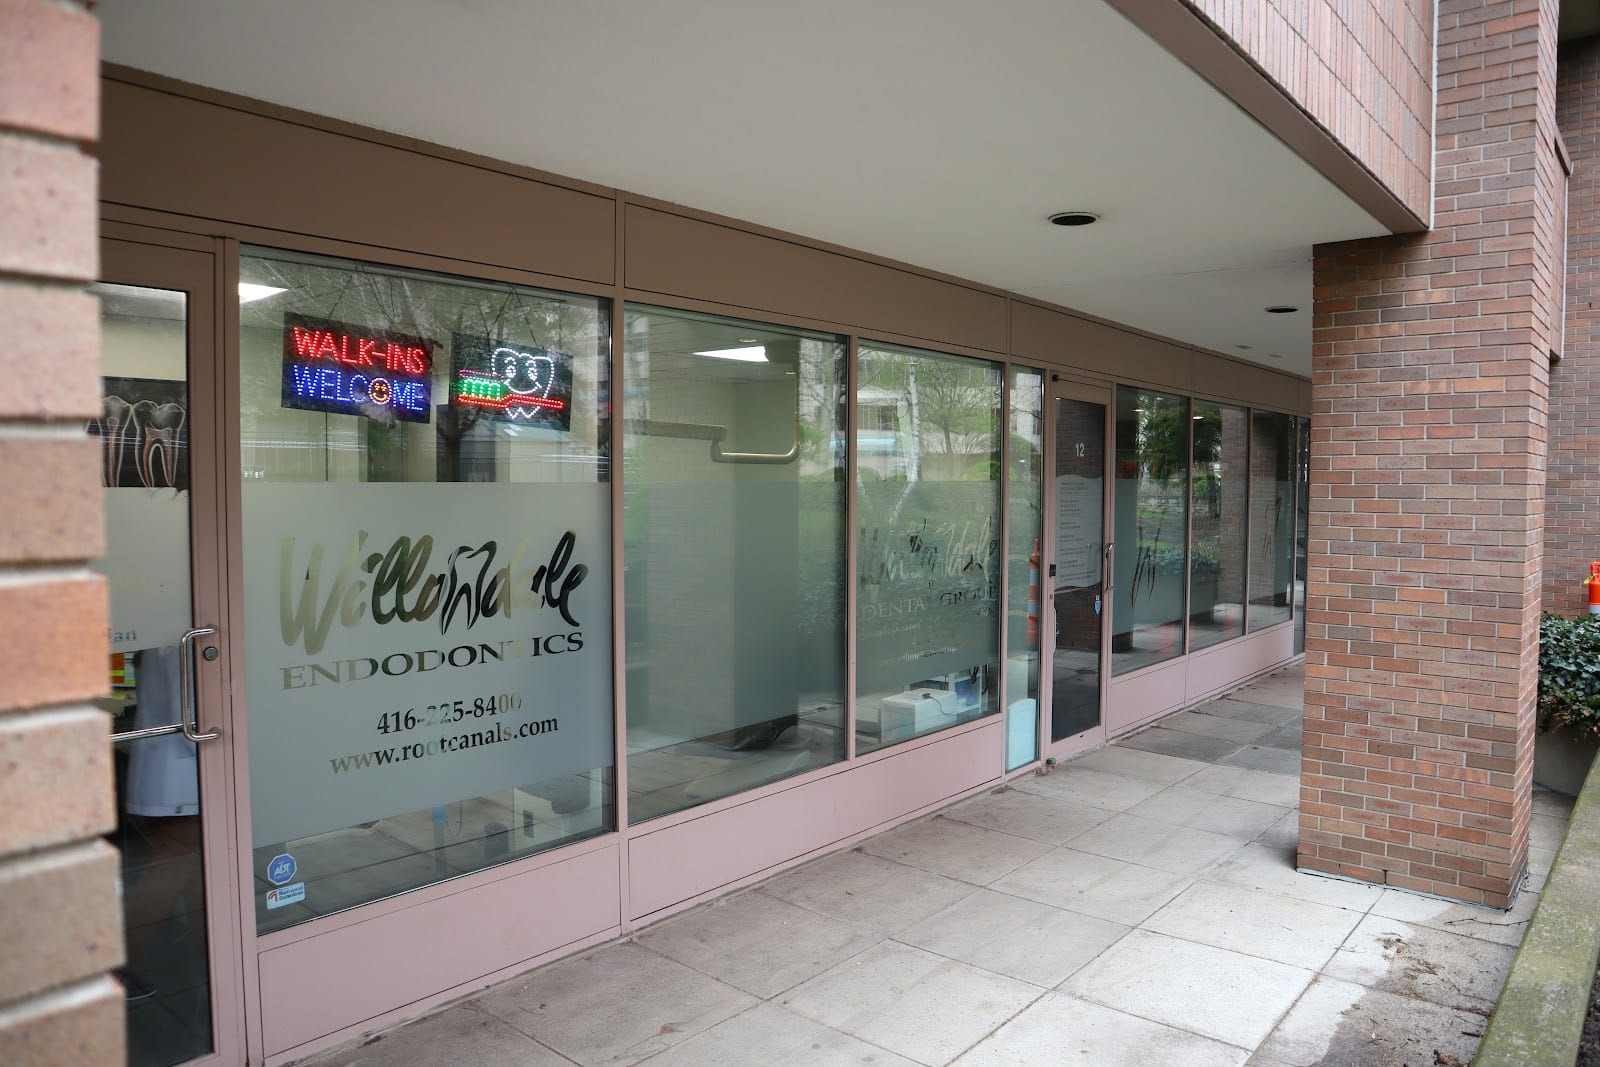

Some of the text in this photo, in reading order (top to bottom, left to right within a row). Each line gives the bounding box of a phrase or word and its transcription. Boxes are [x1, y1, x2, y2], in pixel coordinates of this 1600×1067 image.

[293, 325, 424, 374] WALK-INS
[293, 364, 423, 411] WELCOME
[1075, 442, 1085, 457] 12
[376, 691, 523, 734] 416-225-8400
[330, 716, 559, 775] www.rootcanals.com
[274, 862, 291, 876] ADT
